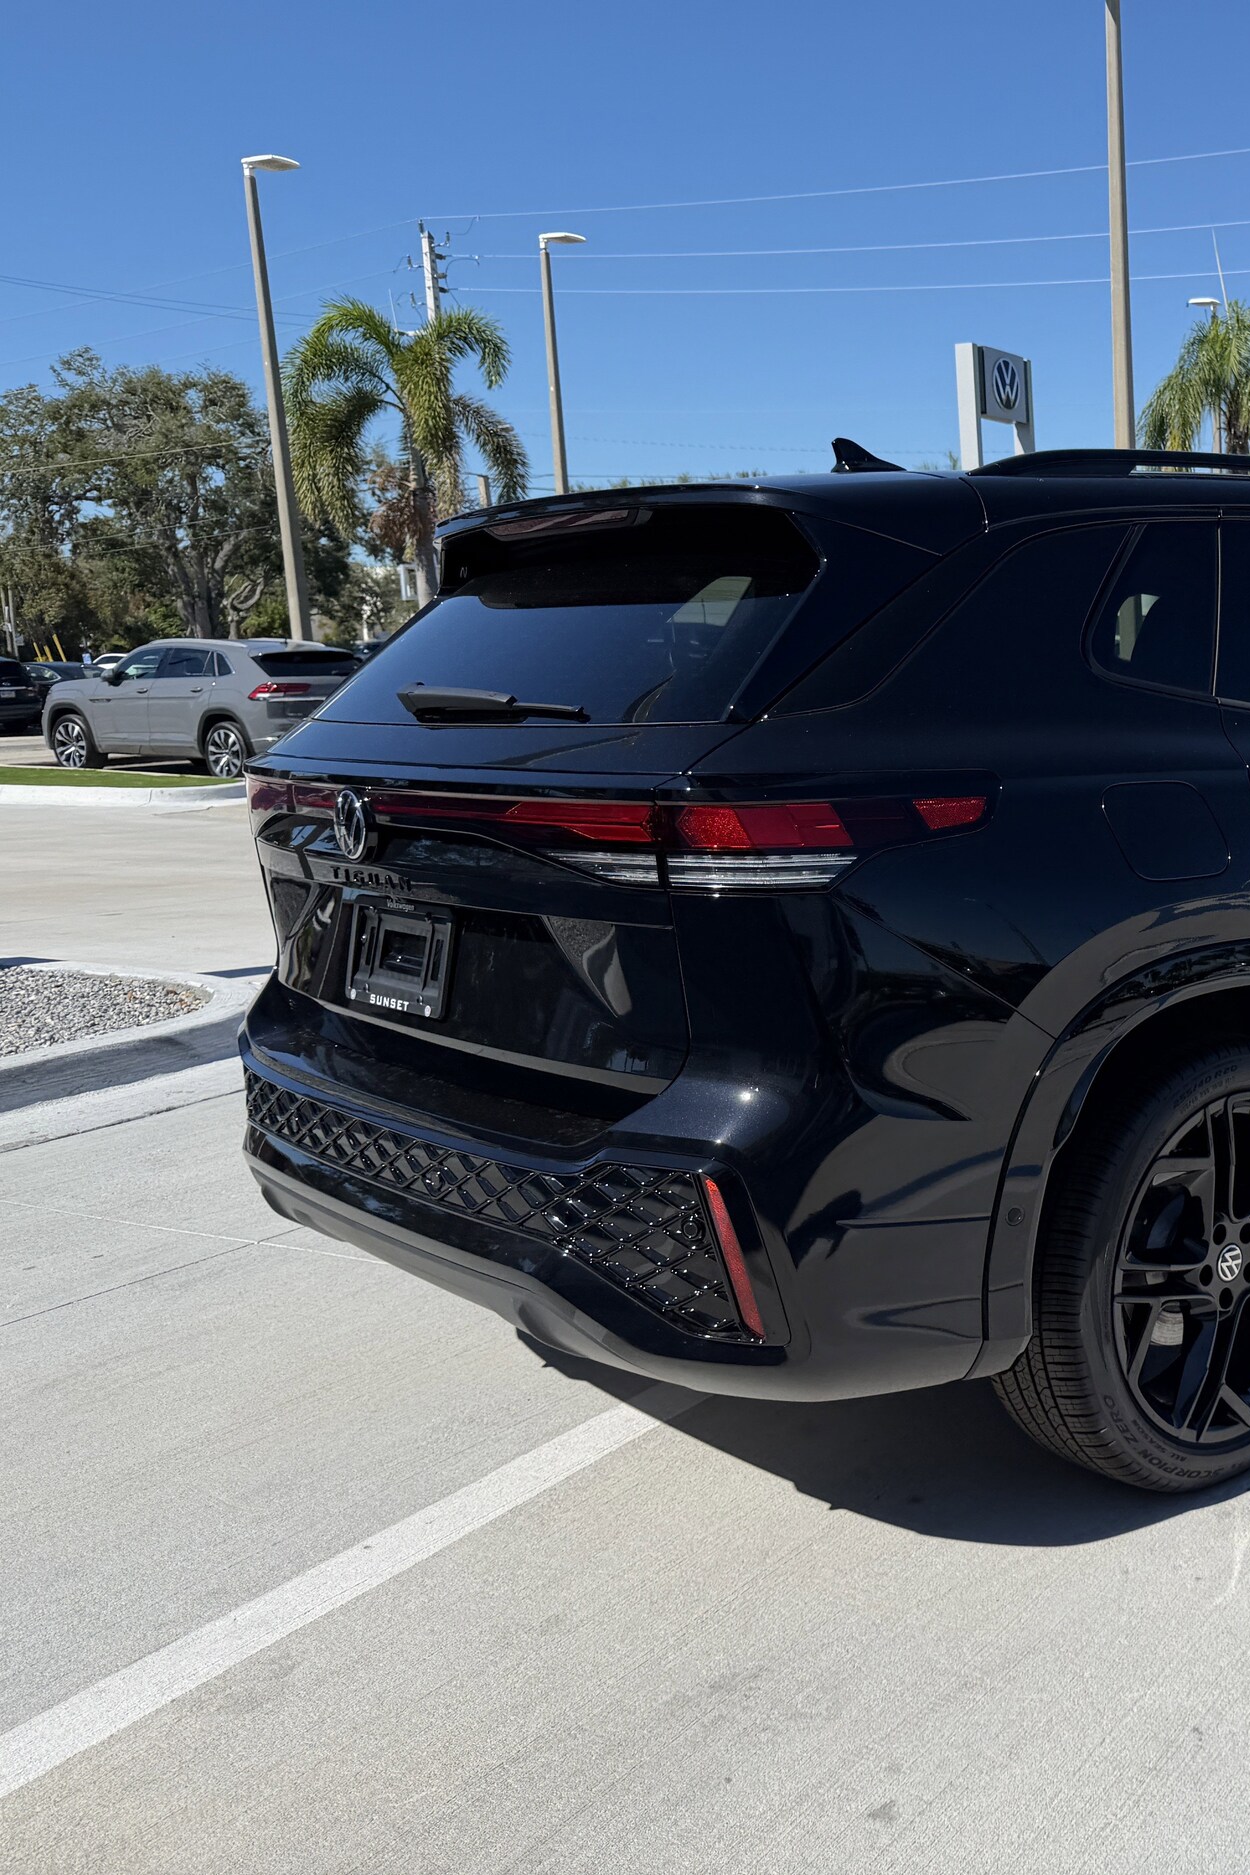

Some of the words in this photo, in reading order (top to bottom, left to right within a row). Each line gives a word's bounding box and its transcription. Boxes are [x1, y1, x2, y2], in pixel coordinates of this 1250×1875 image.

[330, 866, 412, 892] TIGUAN
[369, 993, 410, 1012] SUNSET
[1103, 1394, 1138, 1446] ZERO
[1137, 1449, 1224, 1479] SCORPION
